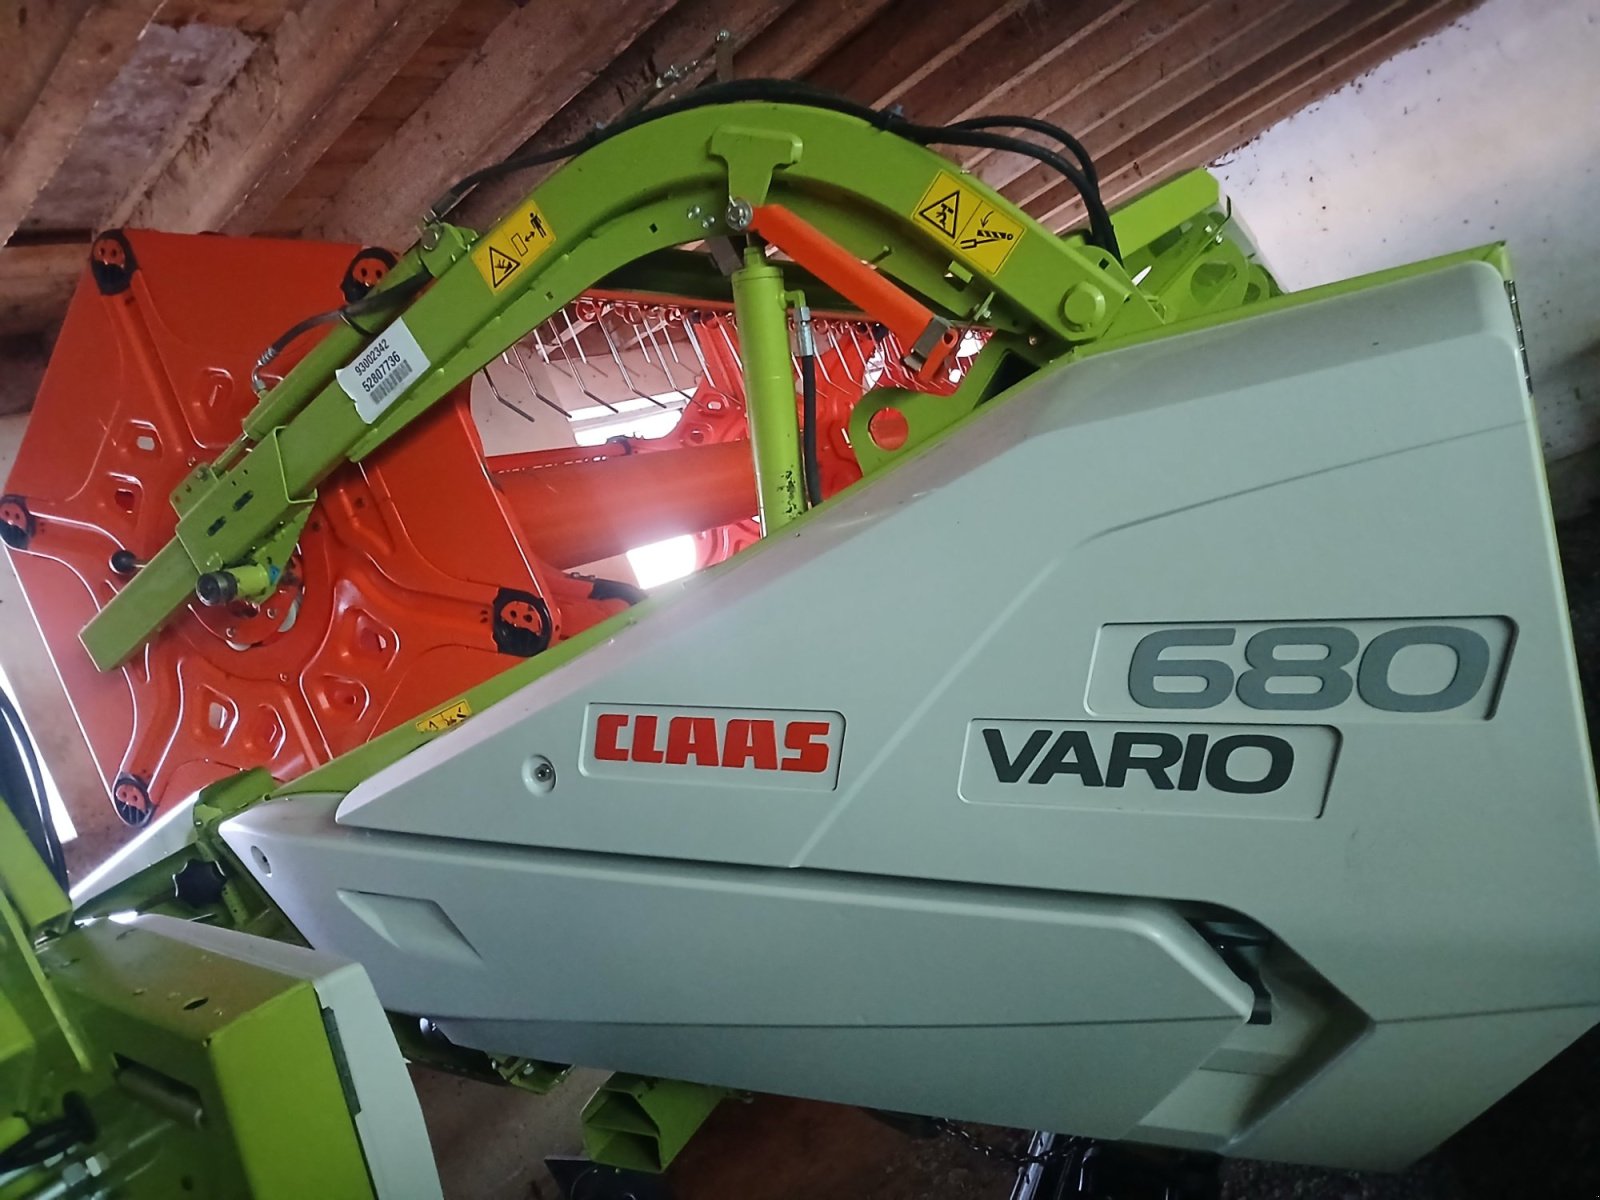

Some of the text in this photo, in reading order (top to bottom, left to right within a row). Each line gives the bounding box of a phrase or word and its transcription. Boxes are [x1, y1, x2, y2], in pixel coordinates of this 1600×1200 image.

[354, 338, 390, 376] 93002342
[361, 351, 401, 392] 52807736
[1127, 625, 1490, 713] 680
[594, 713, 830, 773] CLAAS
[982, 728, 1294, 794] VARIO
